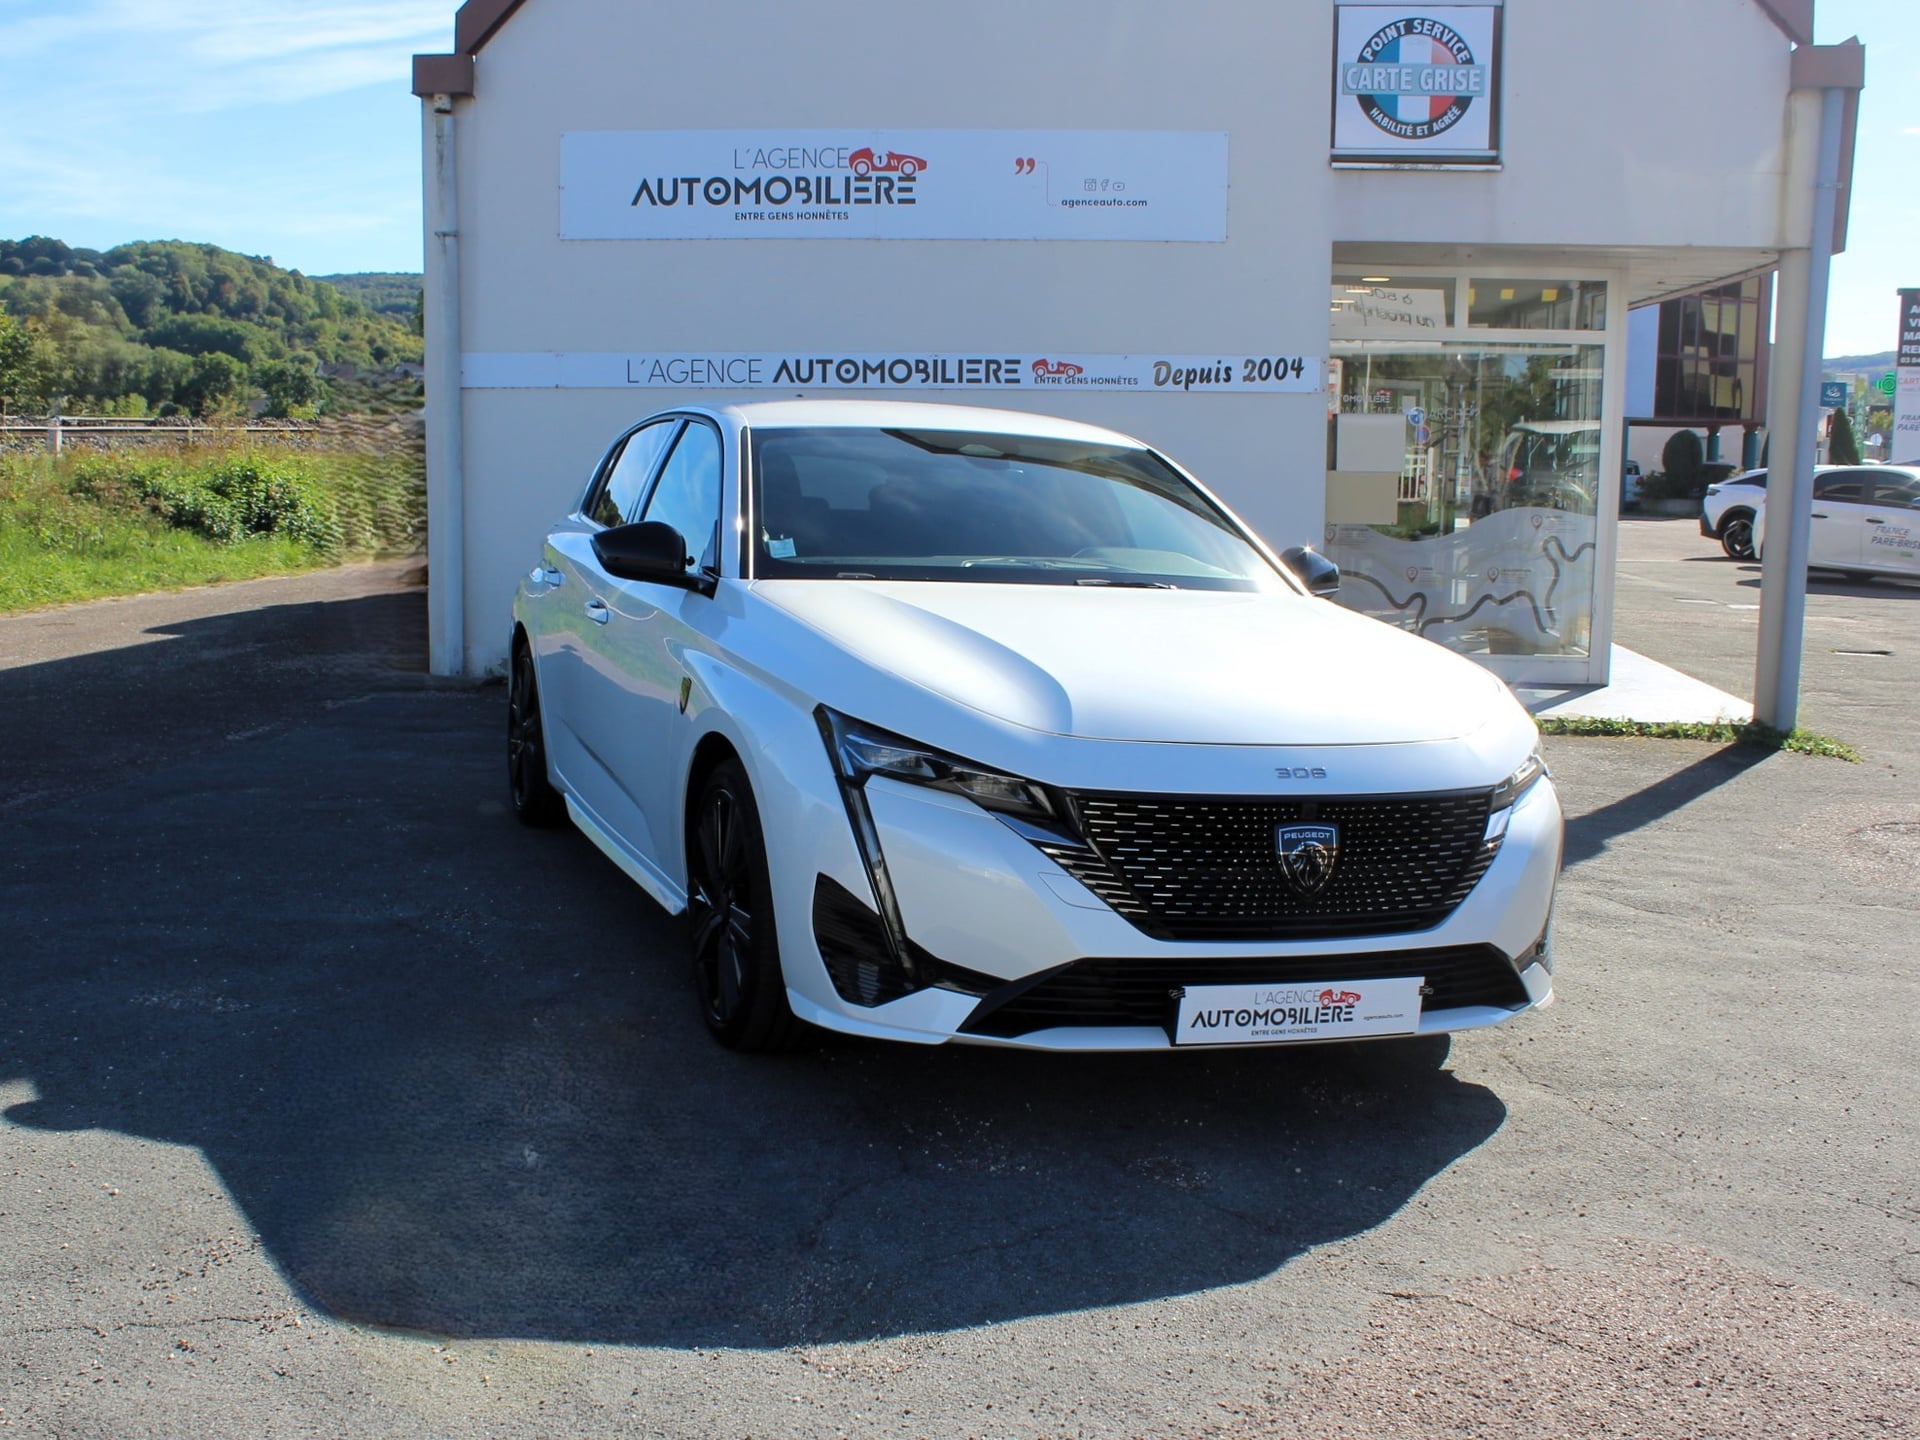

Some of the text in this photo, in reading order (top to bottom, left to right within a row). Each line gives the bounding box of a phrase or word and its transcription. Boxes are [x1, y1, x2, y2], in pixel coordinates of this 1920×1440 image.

[1362, 19, 1471, 64] POINT SERVICE
[1345, 68, 1482, 92] CARTE GRISE
[1416, 126, 1429, 136] ET
[734, 147, 850, 170] L'AGENCE
[1061, 198, 1148, 208] agenceauto.com
[735, 210, 849, 221] ENTRE GENS HONNÊTES
[626, 358, 763, 384] L'AGENCE
[1034, 376, 1138, 385] ENTRE GENS HONNÊTES
[1152, 356, 1305, 392] Depuis 2004
[1254, 989, 1320, 1006] L'AGENCE
